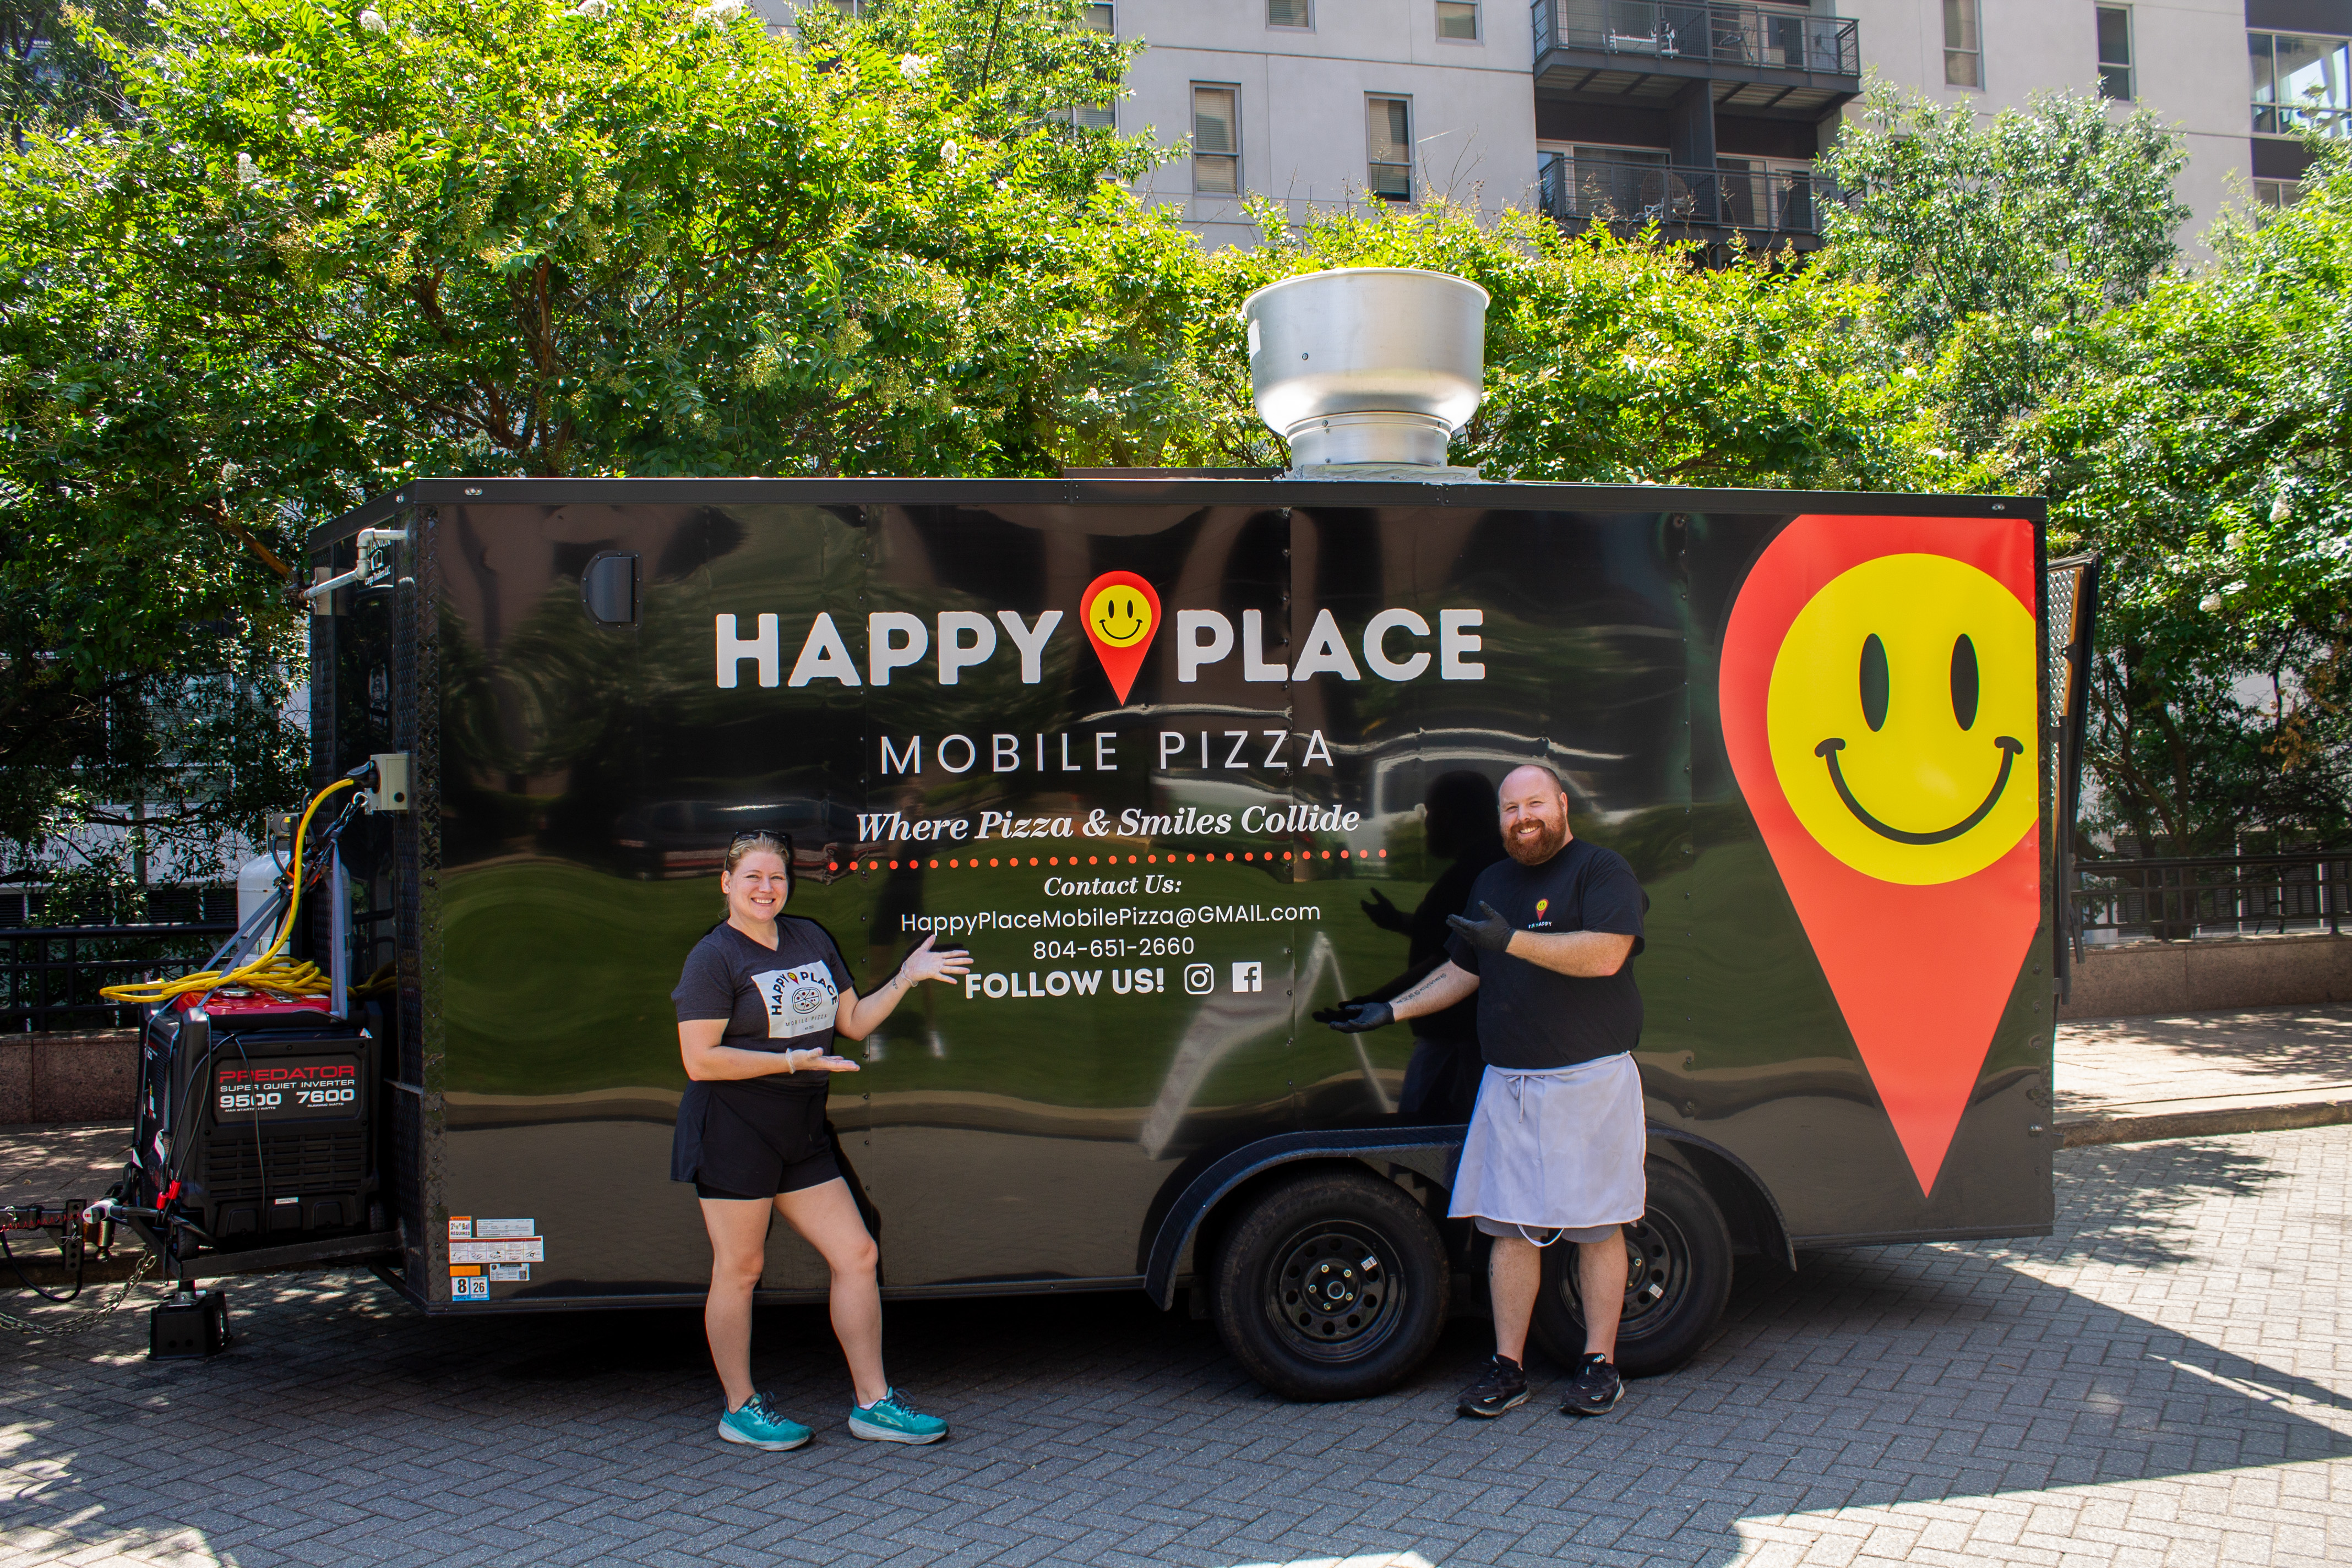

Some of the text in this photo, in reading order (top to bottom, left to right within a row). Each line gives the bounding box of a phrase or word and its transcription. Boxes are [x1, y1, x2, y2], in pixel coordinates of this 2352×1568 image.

[716, 608, 1485, 688] HAPPY PLACE
[881, 729, 1333, 774] MOBILE PIZZA
[856, 804, 1360, 841] Where Pizza & Smiles Collide
[1044, 874, 1182, 896] Contact Us:
[902, 905, 1320, 935] HappyPlaceMobilePizza@GMAIL.com
[1033, 937, 1194, 960] 804-651-2660
[771, 971, 837, 1015] HAPPY PLACE
[965, 967, 1164, 999] FOLLOW US!
[785, 1017, 808, 1027] MOBILE
[219, 1065, 355, 1082] PREDATOR
[301, 1080, 355, 1088] INVERTER
[220, 1089, 355, 1108] 9500 7600
[458, 1278, 485, 1293] 8 26
